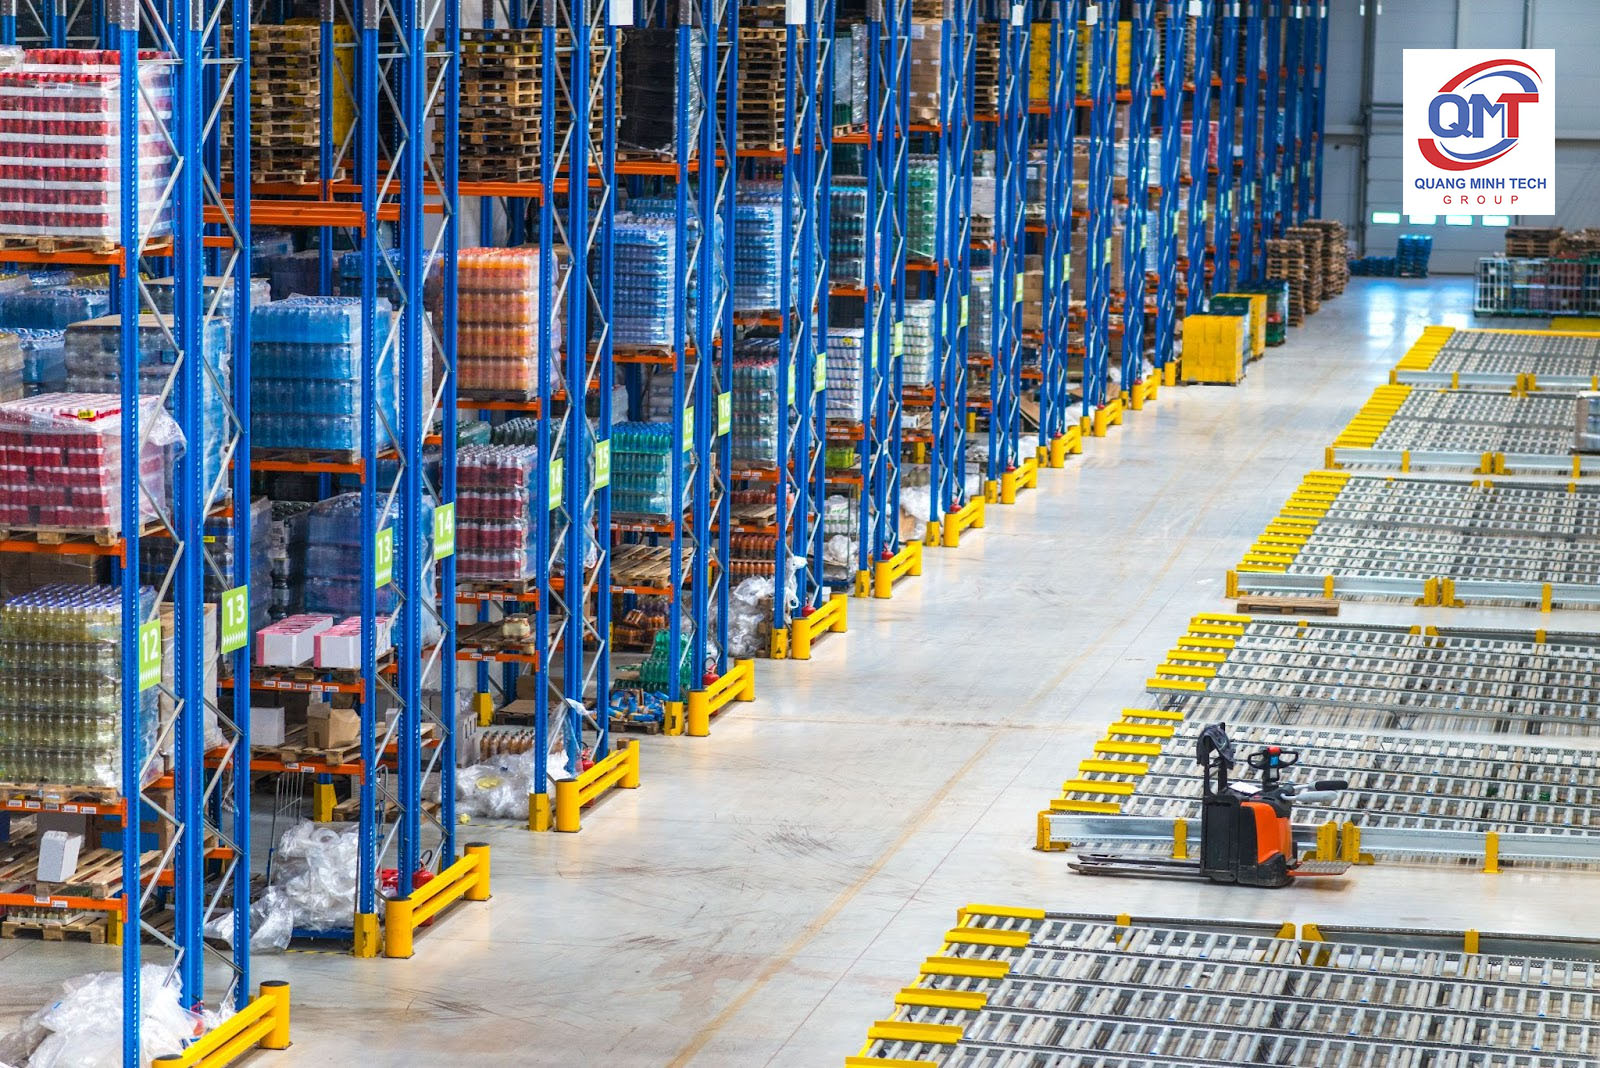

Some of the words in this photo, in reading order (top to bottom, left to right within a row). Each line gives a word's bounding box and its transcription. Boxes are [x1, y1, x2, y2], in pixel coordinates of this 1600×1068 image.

[684, 413, 693, 434] 15
[721, 403, 730, 423] 16
[598, 446, 609, 470] 15
[551, 466, 561, 491] 14
[438, 510, 452, 536] 14
[377, 540, 391, 564] 13
[226, 595, 245, 627] 13
[141, 628, 158, 664] 12
